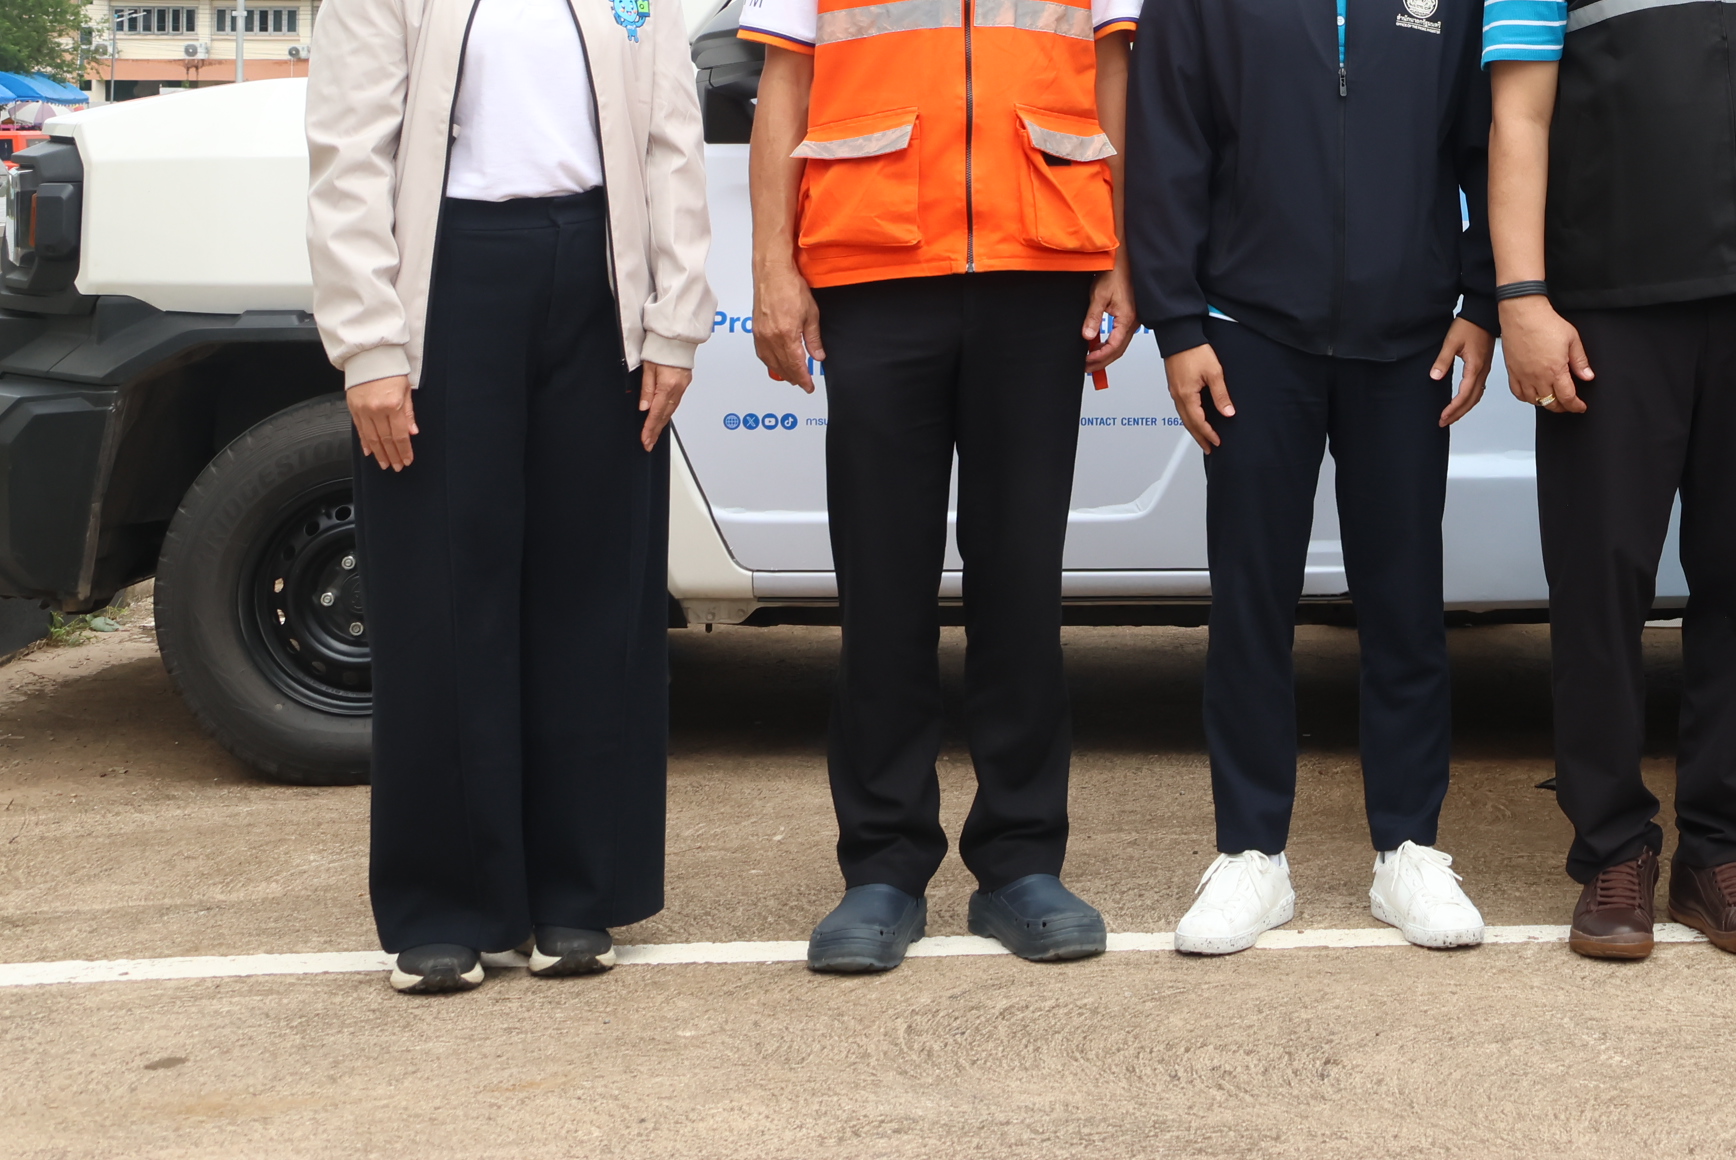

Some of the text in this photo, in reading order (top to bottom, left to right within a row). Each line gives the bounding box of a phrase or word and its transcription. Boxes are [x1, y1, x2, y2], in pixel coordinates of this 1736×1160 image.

[1079, 417, 1185, 427] ONTACT CENTER 1662
